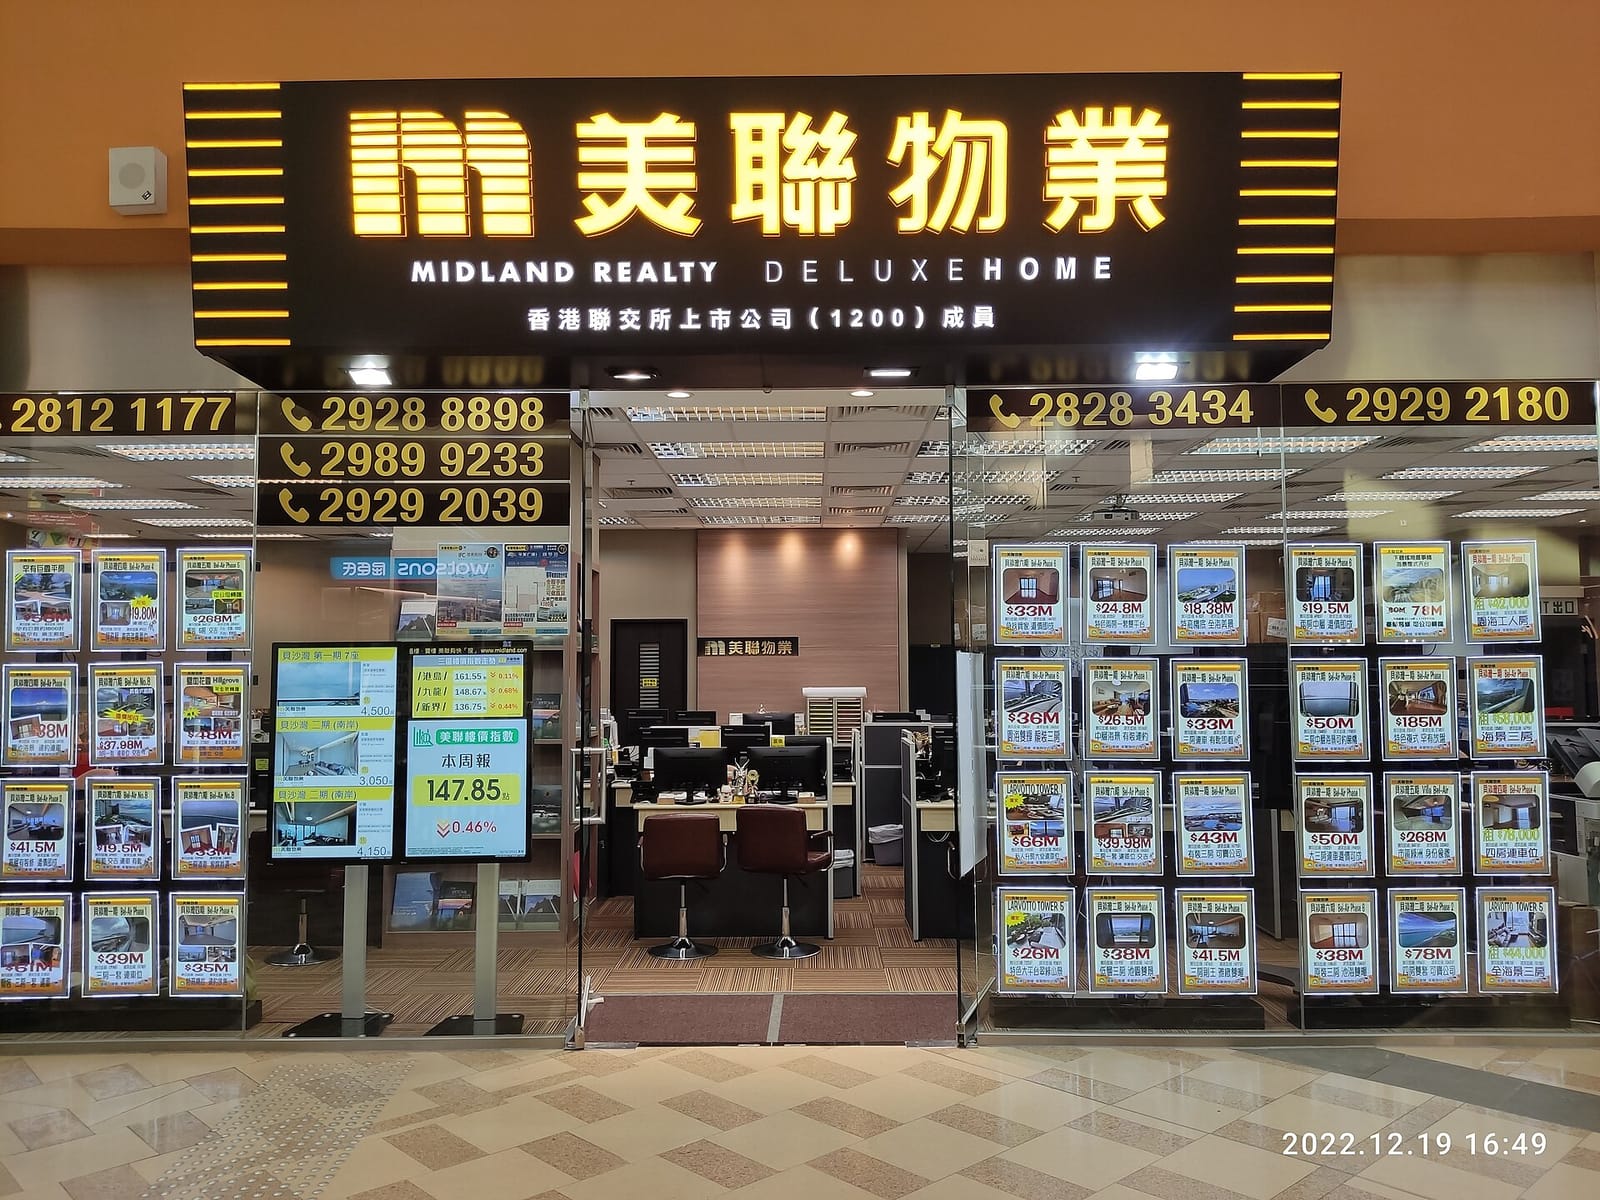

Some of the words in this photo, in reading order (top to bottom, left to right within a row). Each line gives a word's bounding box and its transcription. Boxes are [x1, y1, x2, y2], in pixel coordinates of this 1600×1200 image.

[574, 106, 1169, 237] 美聯物業
[411, 260, 576, 283] MIDLAND
[593, 260, 719, 283] REALTY
[1029, 390, 1134, 428] 2828
[1147, 388, 1255, 426] 3434
[1345, 386, 1452, 423] 2929
[1465, 385, 1570, 422] 2180
[11, 397, 115, 433] 2812
[130, 396, 232, 432] 1177
[321, 396, 427, 432] 2928
[440, 396, 545, 432] 8898
[320, 441, 426, 477] 2989
[440, 441, 545, 477] 9233
[319, 487, 426, 524] 2929
[439, 487, 544, 523] 2039
[1006, 605, 1053, 617] $33M
[1095, 602, 1142, 614] $24.8M
[1183, 602, 1233, 615] $18.38M
[1302, 602, 1349, 614] $19.5M
[1411, 605, 1442, 616] 78M
[1552, 600, 1575, 614] 出口
[192, 615, 232, 624] $268M
[728, 640, 793, 656] 美聯物業
[212, 676, 239, 686] Hillgrove
[454, 672, 482, 680] 161.55
[454, 687, 482, 696] 148.67
[454, 703, 482, 711] 136.75
[1007, 711, 1060, 725] $36M
[1098, 715, 1145, 726] $26.5M
[1186, 718, 1234, 730] $33M
[1306, 717, 1354, 729] $50M
[1395, 716, 1442, 728] $185M
[439, 730, 515, 743] 美聯樓價指數
[1481, 730, 1534, 742] 海景三房
[98, 740, 143, 751] $37.98M
[441, 753, 491, 769] 本周報
[359, 775, 389, 786] 3,050
[427, 778, 501, 802] 147.85
[1035, 783, 1059, 795] TOWER
[452, 820, 497, 834] 0.46%
[1012, 835, 1059, 848] $66M
[1097, 836, 1151, 849] $39.98M
[1190, 832, 1238, 844] $43M
[1311, 833, 1358, 845] $50M
[1399, 831, 1447, 843] $268M
[10, 841, 56, 853] $41.5M
[97, 842, 142, 854] $19.5M
[356, 846, 387, 857] 4,150
[1485, 847, 1539, 859] 四房連車位
[1037, 900, 1059, 912] TOWER
[1515, 901, 1538, 912] TOWER
[97, 952, 144, 965] $39M
[1012, 947, 1060, 960] $26M
[1102, 947, 1150, 960] $38M
[1192, 949, 1240, 961] $41.5M
[1315, 949, 1363, 961] $38M
[1404, 948, 1452, 960] $78M
[184, 962, 229, 973] $35M
[1491, 965, 1545, 976] 全海景三房
